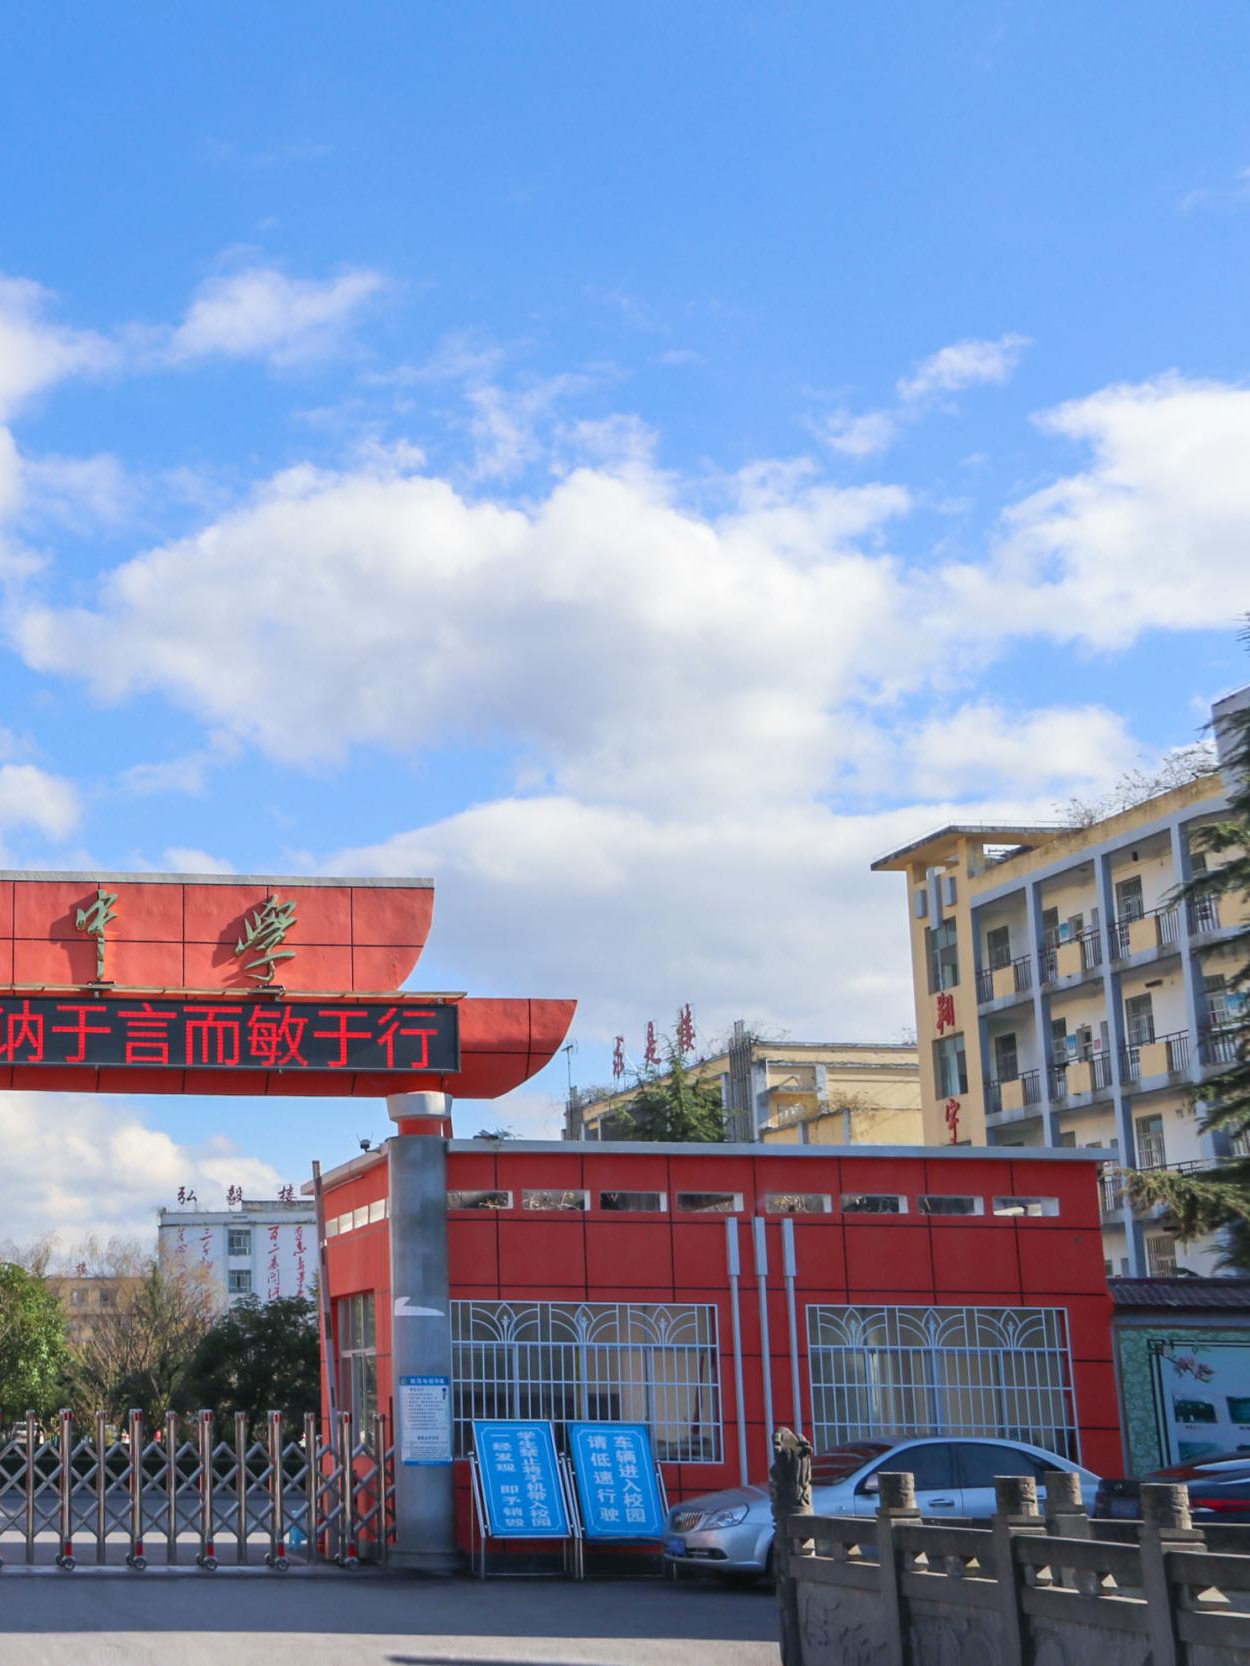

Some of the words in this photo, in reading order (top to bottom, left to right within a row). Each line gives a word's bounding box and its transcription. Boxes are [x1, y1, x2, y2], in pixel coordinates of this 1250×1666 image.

[491, 1433, 517, 1473] 一经发现
[516, 1431, 551, 1527] 学生禁止将手机带入校园
[587, 1435, 620, 1522] 请低速行驶
[613, 1435, 647, 1523] 车辆进入校园
